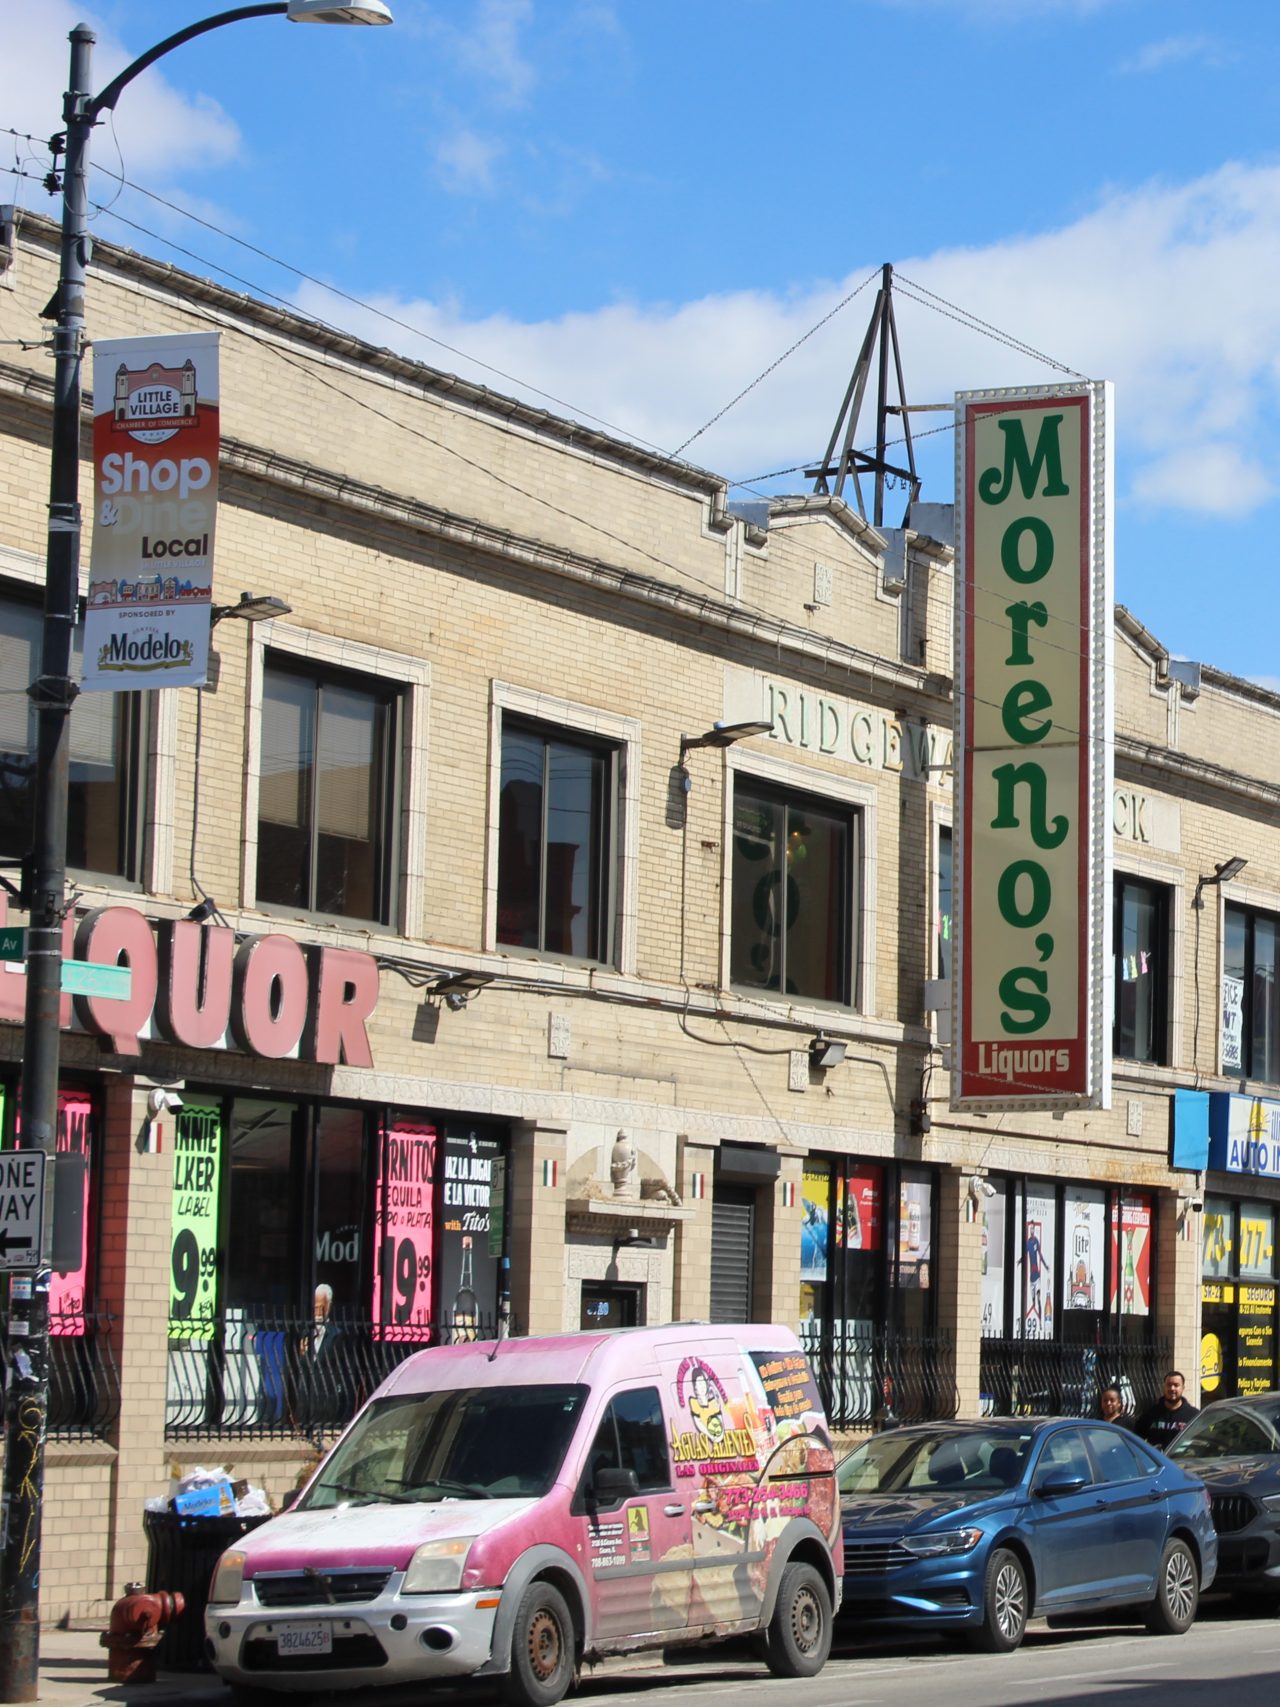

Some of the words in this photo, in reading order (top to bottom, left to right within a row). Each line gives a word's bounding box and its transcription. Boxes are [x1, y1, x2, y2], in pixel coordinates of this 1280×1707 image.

[137, 390, 172, 403] LITTLE
[130, 402, 179, 416] VILLAGE
[101, 452, 212, 499] Shop
[142, 533, 209, 559] Local
[118, 610, 163, 620] SPONSORED
[165, 609, 176, 617] BY
[109, 632, 182, 662] Modelo
[2, 938, 18, 951] Av
[978, 1043, 1070, 1082] Liquors
[1229, 1139, 1269, 1171] AUTO
[0, 1161, 36, 1188] NE
[178, 1196, 211, 1217] LABEL
[444, 1219, 462, 1231] with
[463, 1210, 491, 1232] Tito's
[1075, 1234, 1089, 1258] Lite
[675, 1463, 696, 1478] LAS
[699, 1459, 760, 1476] ORIGINALES
